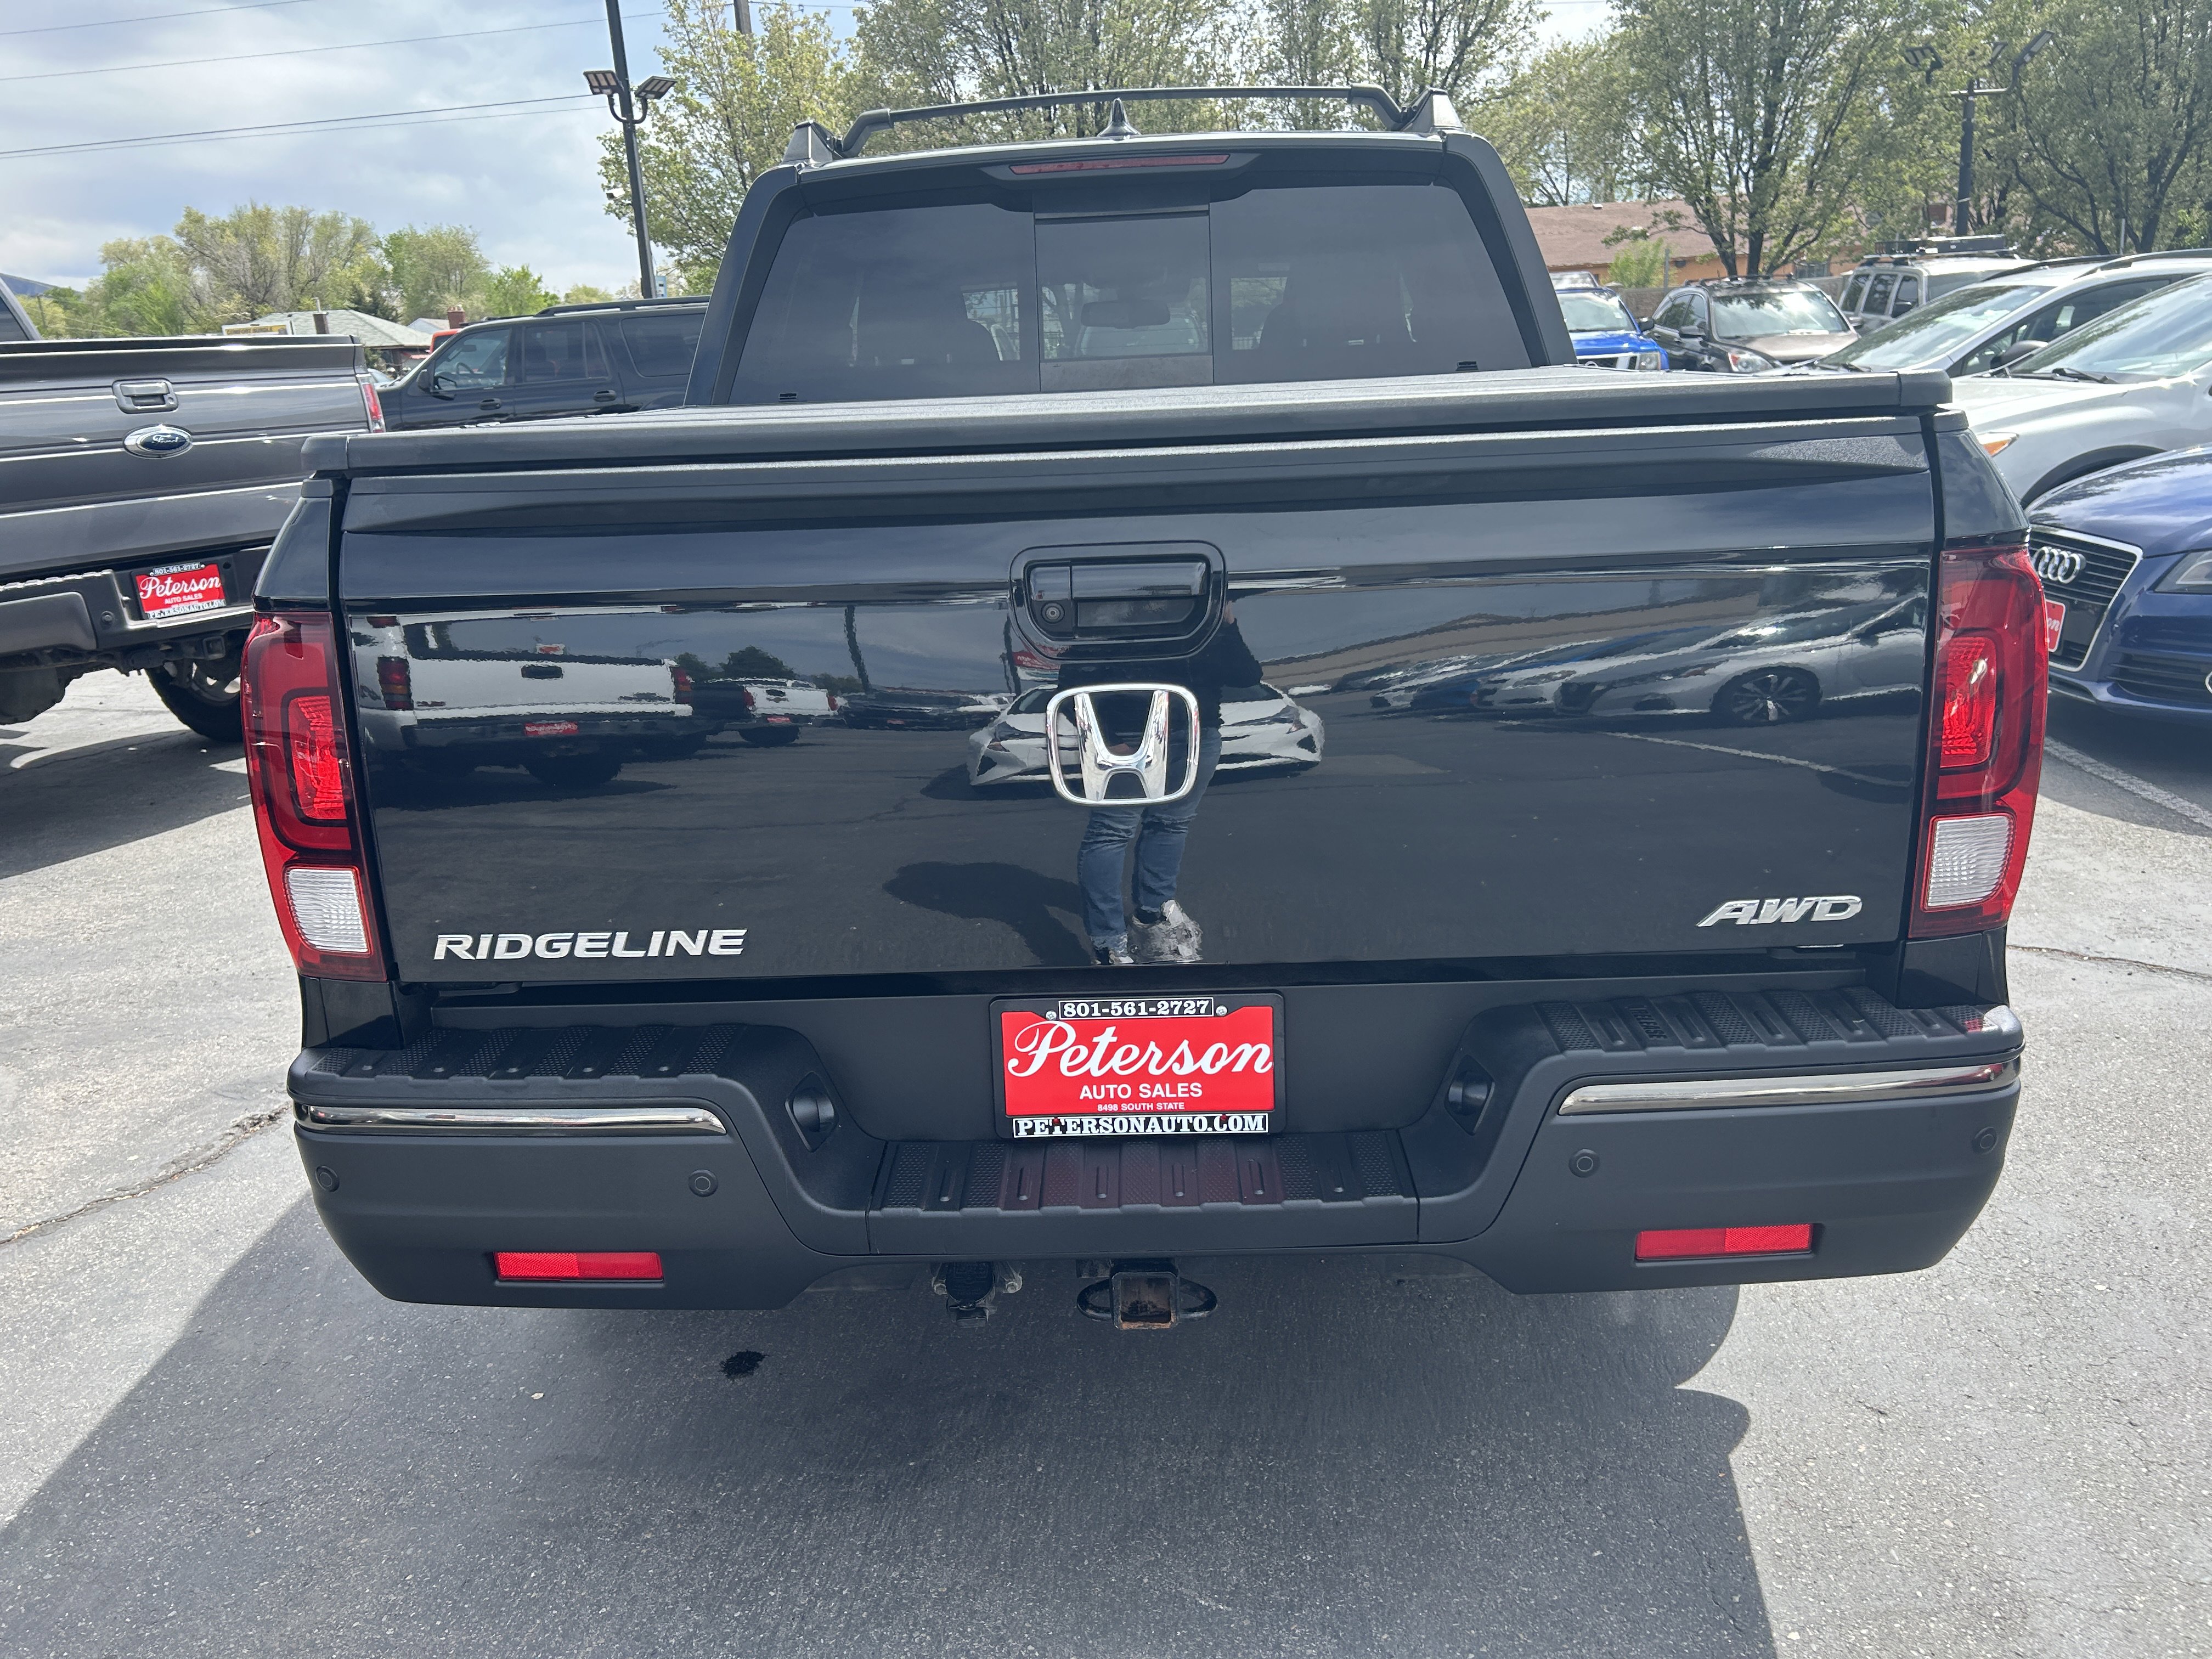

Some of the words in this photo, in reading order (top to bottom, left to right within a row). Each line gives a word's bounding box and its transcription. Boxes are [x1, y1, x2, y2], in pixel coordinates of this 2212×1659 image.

[152, 434, 179, 443] Ford
[139, 576, 221, 599] Peterson
[165, 596, 182, 605] AUTO
[182, 592, 203, 602] SALES
[1696, 895, 1863, 927] AWD
[433, 929, 747, 960] RIDGELINE
[1063, 1000, 1209, 1018] 801-561-2727
[1007, 1020, 1273, 1077] Peterson
[1079, 1084, 1132, 1100] AUTO
[1138, 1082, 1203, 1098] SALES
[1097, 1103, 1119, 1111] 8498
[1121, 1102, 1154, 1111] SOUTH
[1156, 1102, 1185, 1110] STATE
[1017, 1114, 1264, 1136] PETERSONAUTO.COM
